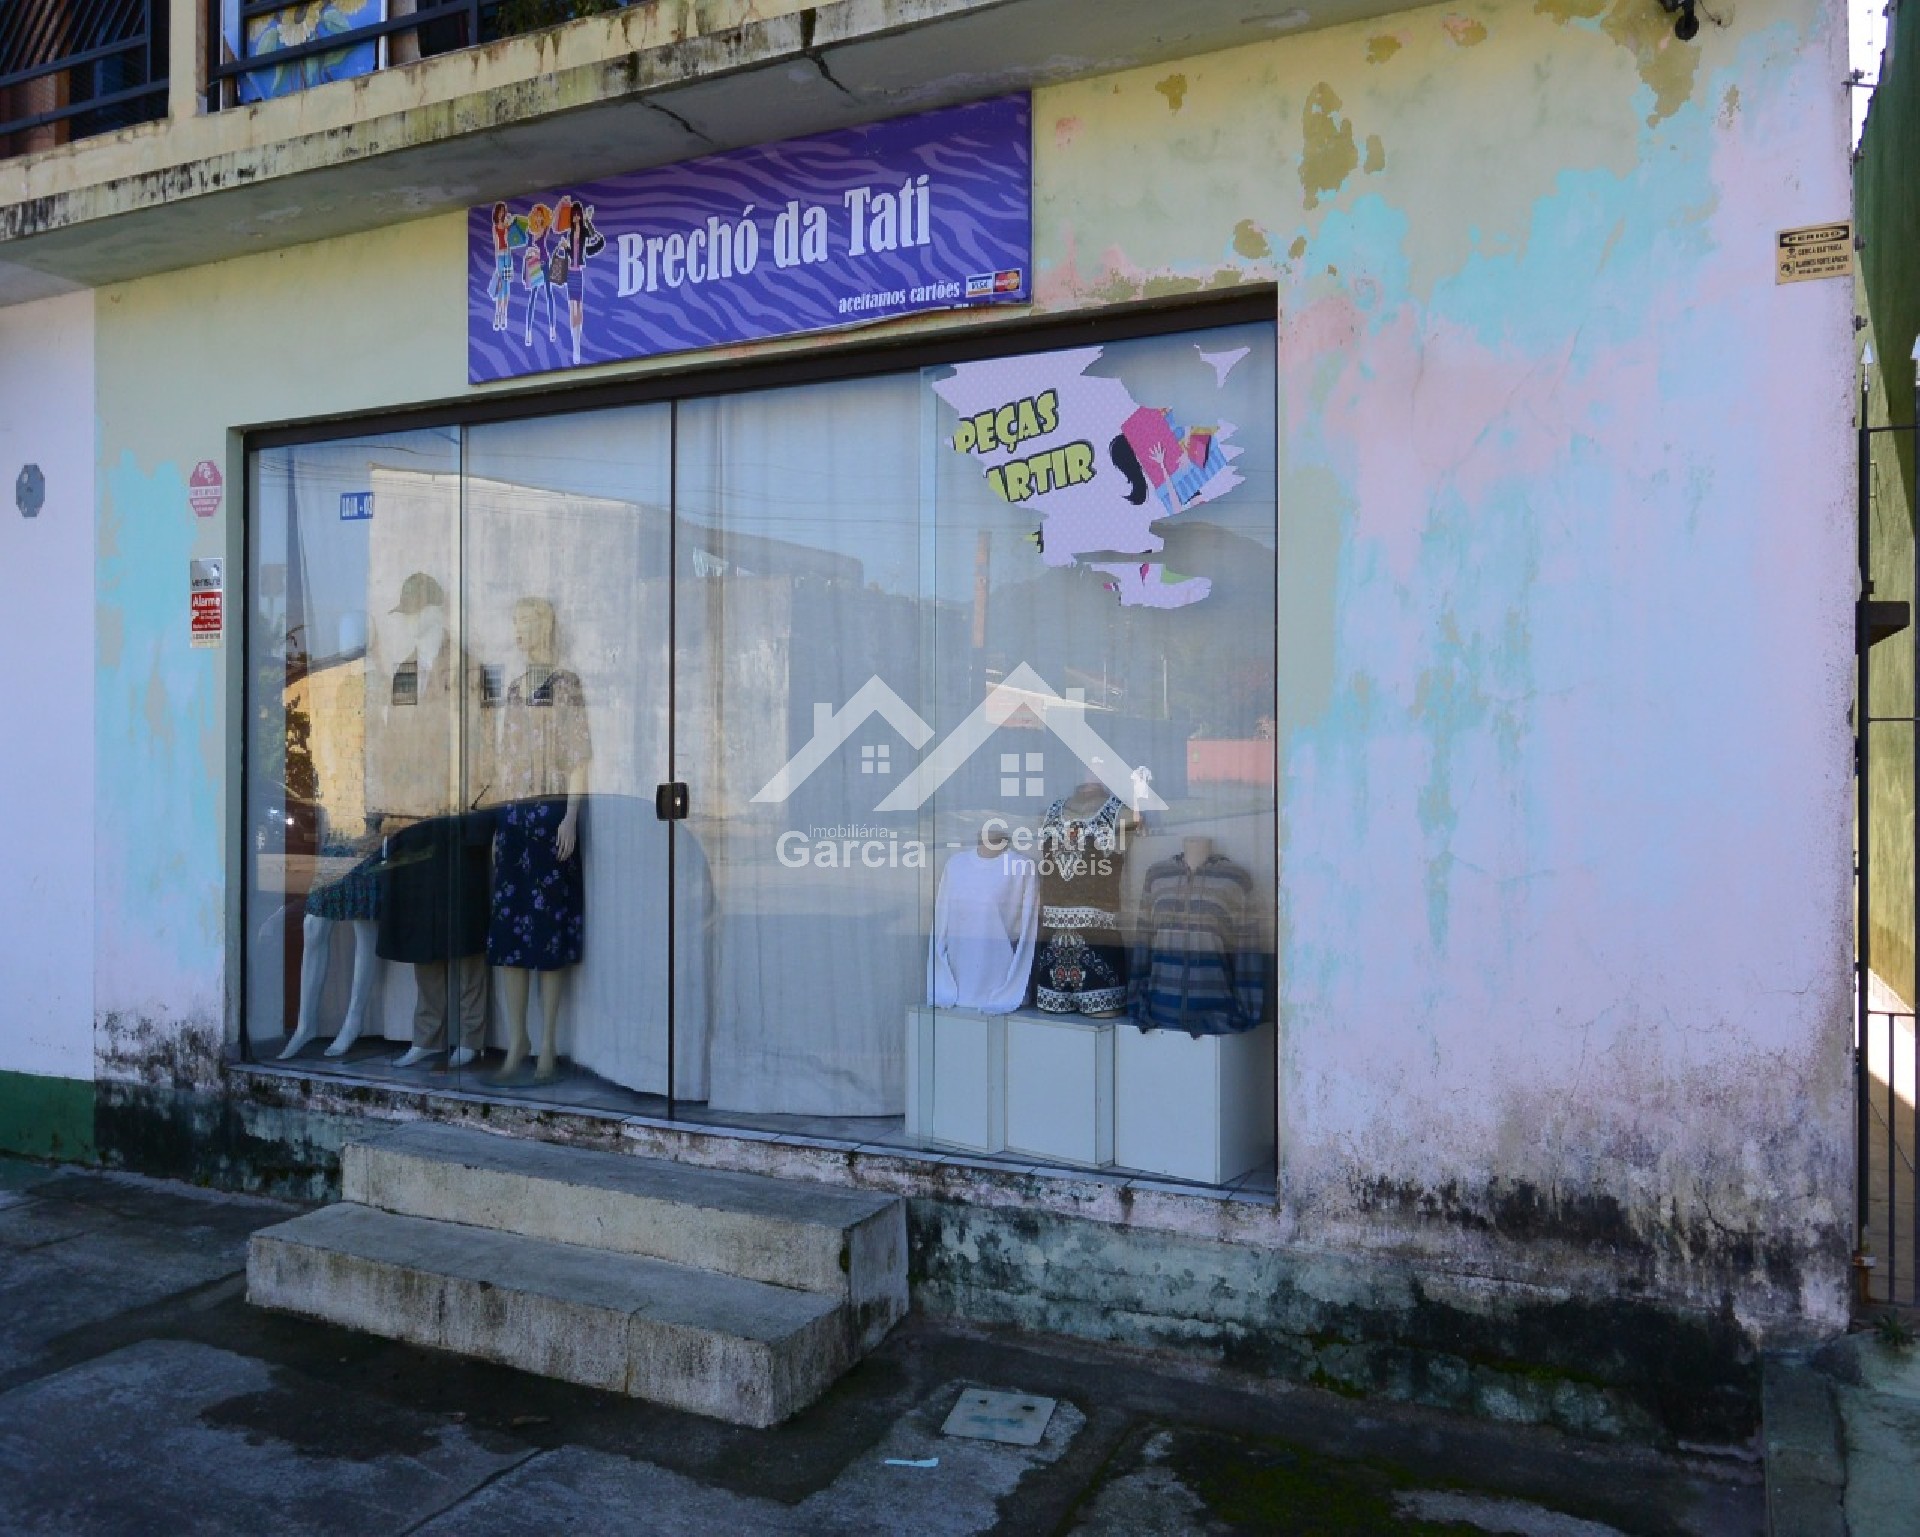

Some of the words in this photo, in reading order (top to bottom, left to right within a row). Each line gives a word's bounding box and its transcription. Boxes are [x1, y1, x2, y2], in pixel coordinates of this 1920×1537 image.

[617, 204, 758, 298] Brechó
[774, 201, 828, 269] da
[844, 174, 931, 256] Tati
[839, 288, 906, 314] aceitamos
[910, 280, 960, 303] cartões
[953, 388, 1059, 454] PEÇAS
